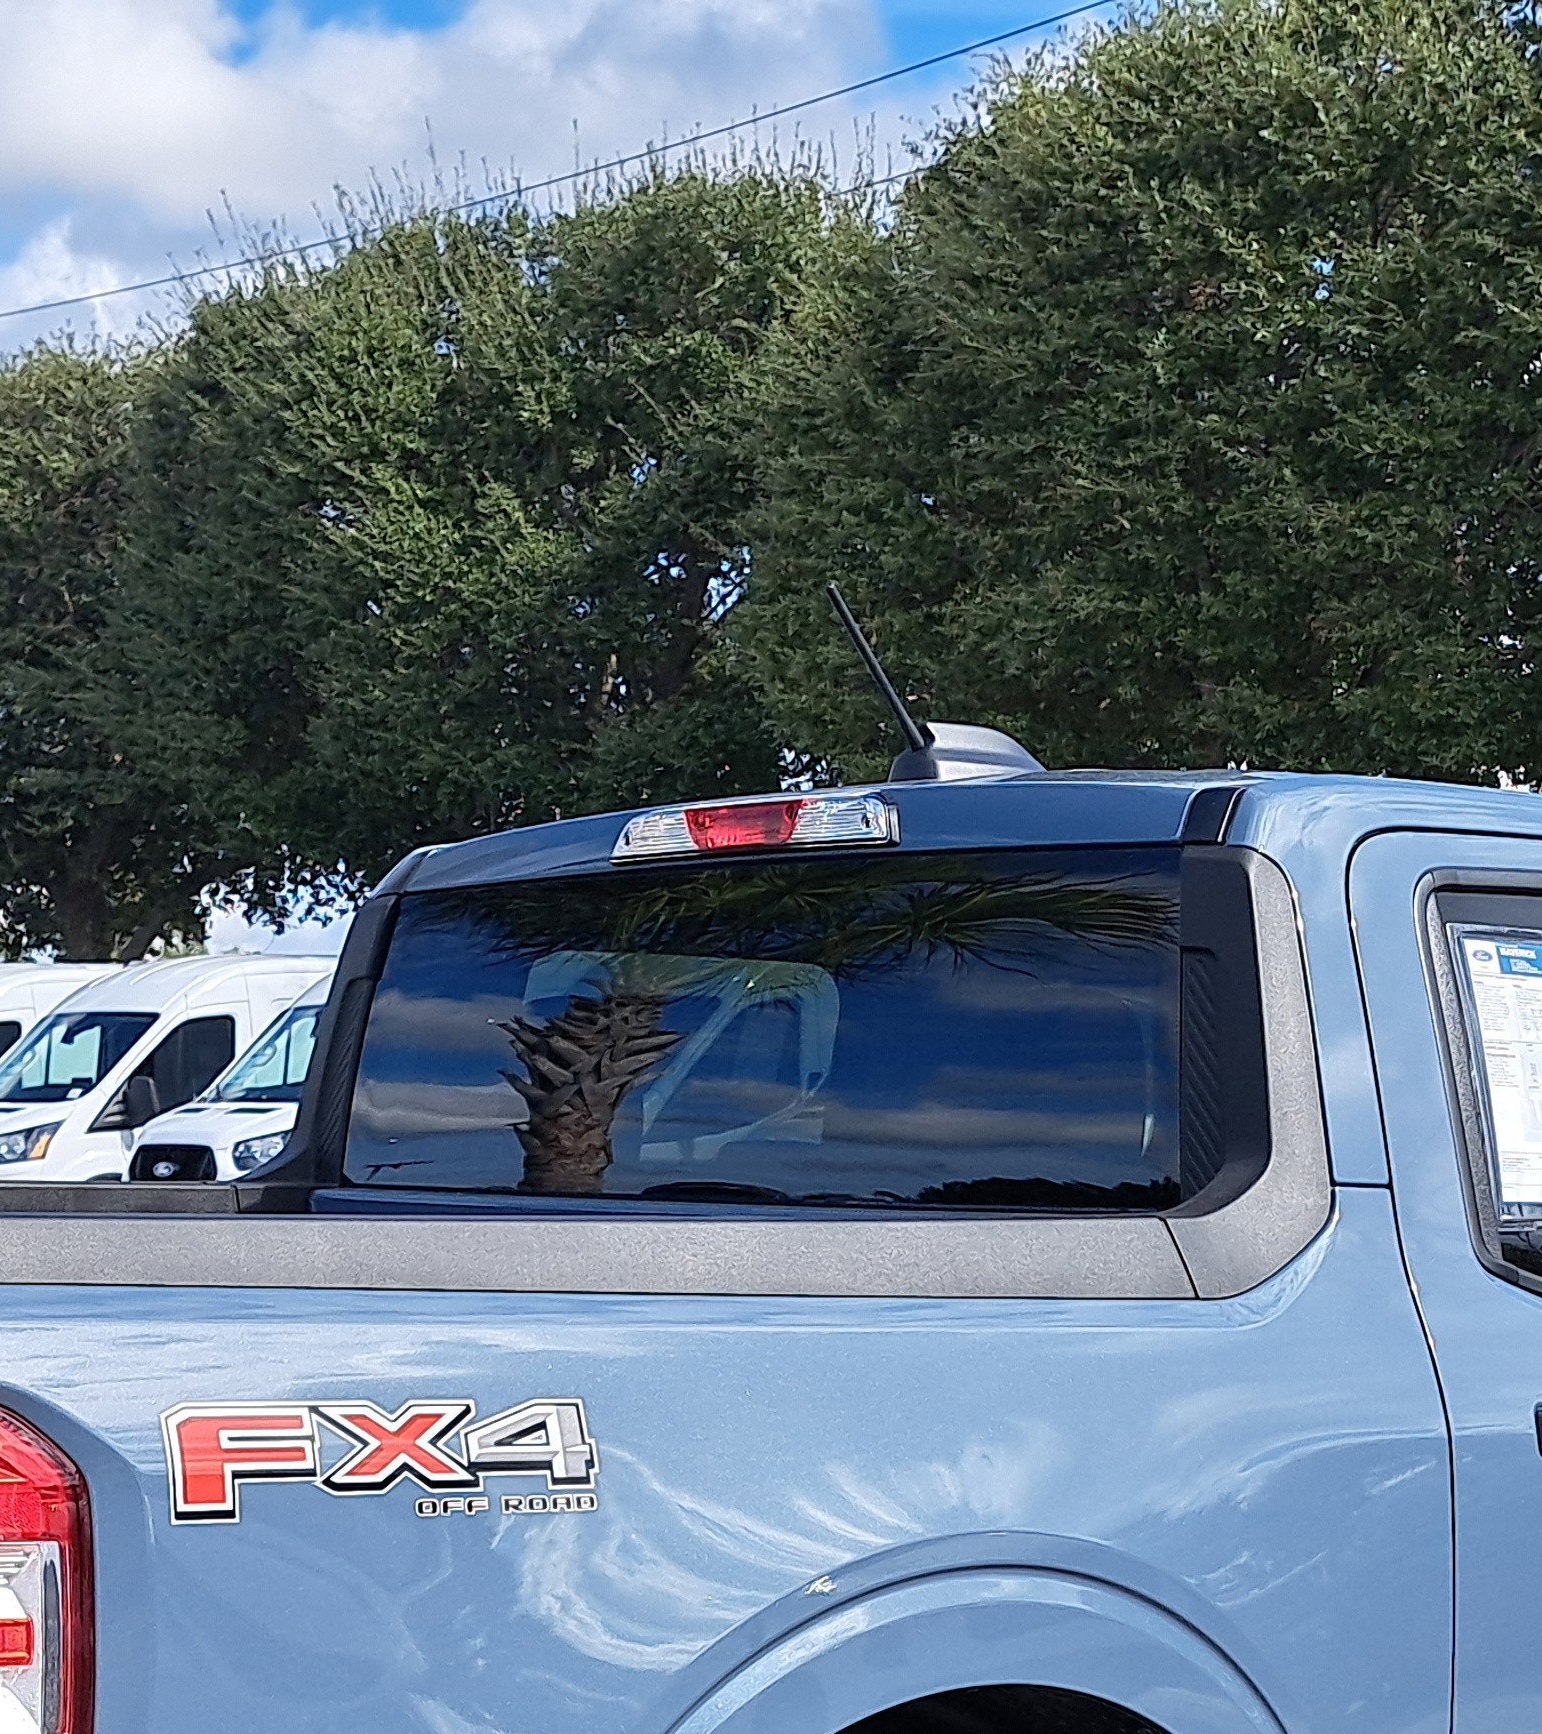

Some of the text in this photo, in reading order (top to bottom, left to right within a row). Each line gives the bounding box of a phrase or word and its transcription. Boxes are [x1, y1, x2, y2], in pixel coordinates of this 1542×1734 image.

[159, 1399, 600, 1525] FX4
[415, 1494, 598, 1518] OFF ROAD
